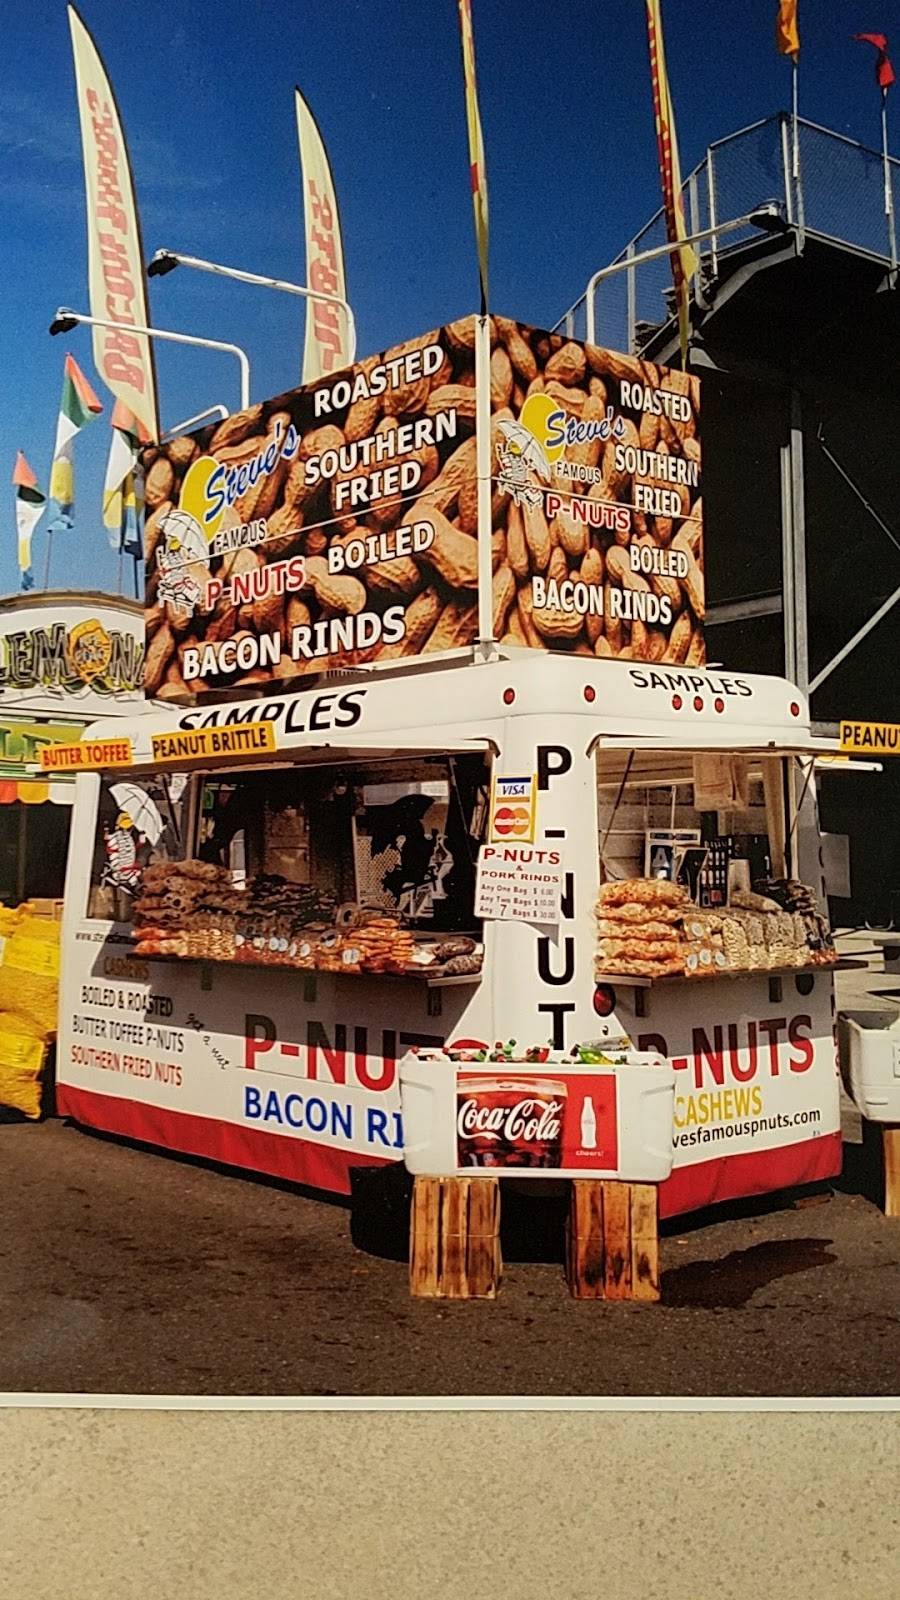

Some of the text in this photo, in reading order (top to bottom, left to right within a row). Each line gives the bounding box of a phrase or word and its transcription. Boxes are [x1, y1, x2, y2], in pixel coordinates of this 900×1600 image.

[314, 345, 444, 417] ROASTED
[621, 381, 691, 423] ROASTED
[304, 410, 457, 484] SOUTHERN
[546, 406, 625, 447] Steve's
[205, 421, 300, 522] Steve's
[336, 461, 420, 510] FRIED
[557, 461, 601, 484] FAMOUS
[615, 443, 698, 487] SOUTHERN
[548, 494, 630, 530] P-NUTS
[635, 484, 682, 518] FRIED
[215, 519, 266, 550] FAMOUS
[329, 522, 434, 573] BOILED
[630, 545, 688, 579] BOILED
[207, 558, 305, 609] P-NUTS
[532, 577, 672, 626] BACON RINDS
[183, 606, 405, 680] BACON RINDS
[628, 670, 753, 698] SAMPLES
[179, 690, 367, 734] SAMPLES
[43, 747, 83, 766] BUTTER
[86, 743, 129, 763] TOFFEE
[152, 727, 267, 759] PEANUT BRITTLE
[843, 725, 900, 748] PEANU
[502, 784, 525, 795] VISA
[481, 870, 559, 883] PORK RINDS
[483, 848, 560, 865] P-NUTS
[500, 904, 507, 916] 7
[82, 985, 174, 1017] BOILED & ROASTED
[72, 1014, 185, 1053] BUTTER TOFFEE P-NUTS
[70, 1045, 183, 1086] SOUTHERN FRIED NUTS
[244, 1086, 352, 1141] BACON
[457, 1098, 563, 1141] Coca-Cola
[673, 1085, 762, 1127] CASHEWS
